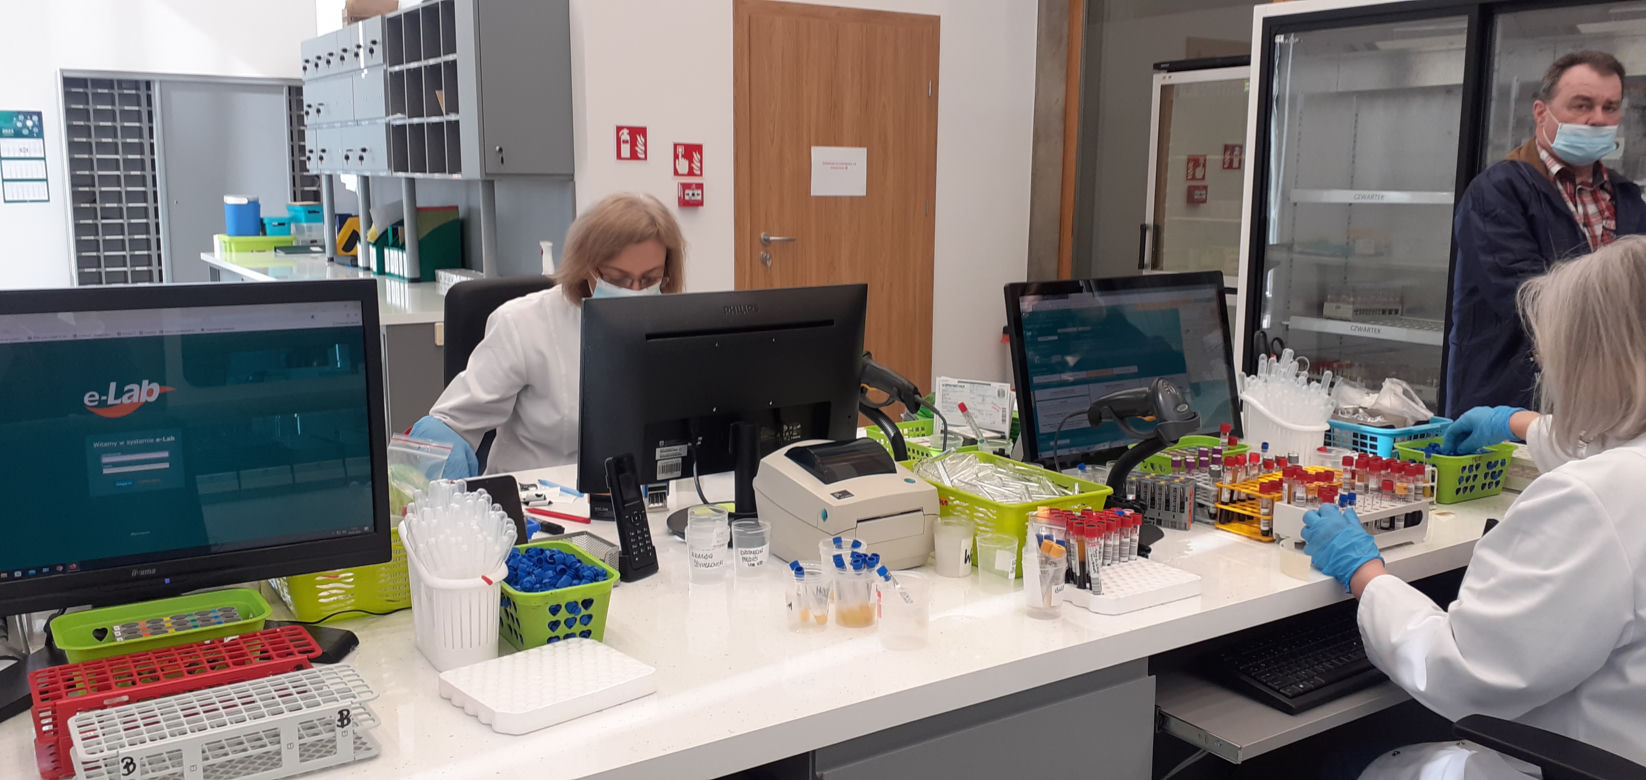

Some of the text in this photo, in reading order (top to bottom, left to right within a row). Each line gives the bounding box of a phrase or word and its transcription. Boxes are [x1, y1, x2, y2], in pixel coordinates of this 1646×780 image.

[1350, 325, 1382, 334] CZWARTEK
[83, 379, 160, 407] e-Lab
[155, 435, 175, 443] e-Lab
